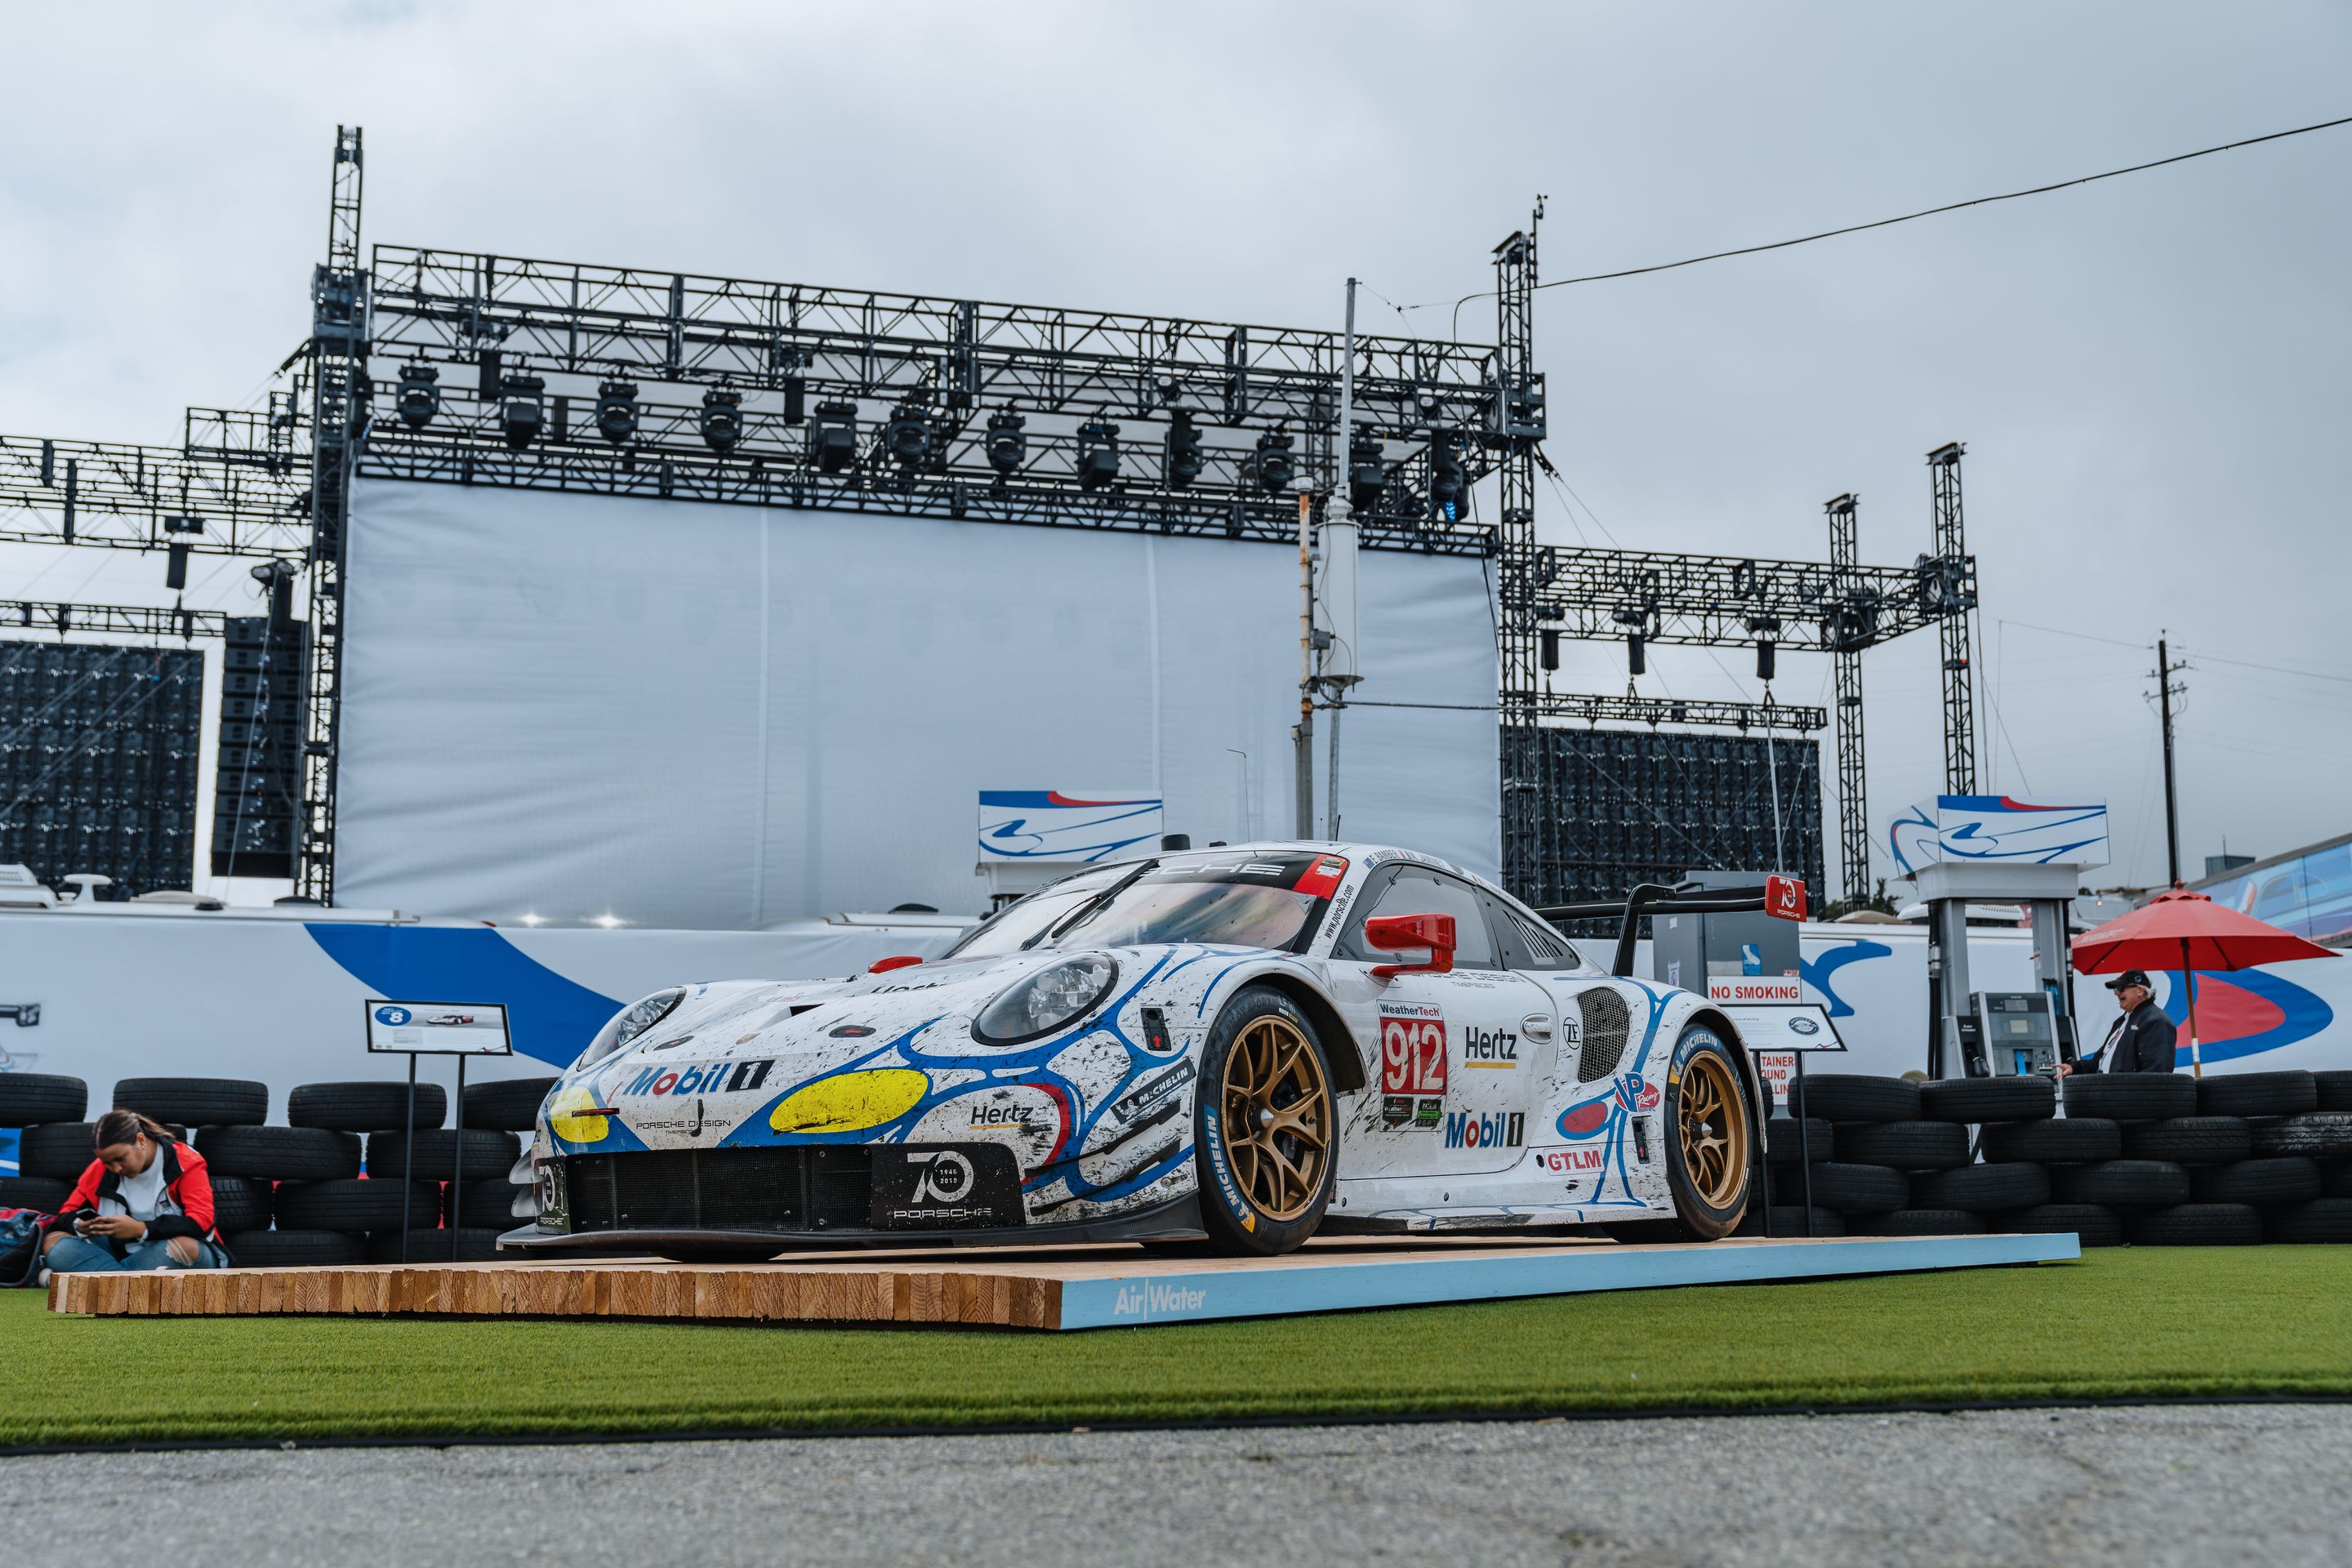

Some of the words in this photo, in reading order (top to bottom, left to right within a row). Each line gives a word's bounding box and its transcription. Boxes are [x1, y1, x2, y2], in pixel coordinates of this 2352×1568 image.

[1780, 878, 1796, 908] 70
[1324, 884, 1354, 939] www.porsche.com
[1777, 909, 1801, 919] PORSCHE
[1711, 986, 1731, 1000] NO
[1735, 986, 1799, 1000] SMOKING
[1380, 1004, 1440, 1018] WeatherTech
[1385, 1022, 1444, 1091] 912
[1465, 1027, 1517, 1060] Hertz
[1680, 1033, 1717, 1062] MICHELIN
[622, 1062, 732, 1096] Mobil
[1138, 1067, 1189, 1105] MICHELIN
[1613, 1072, 1646, 1113] VP
[1637, 1091, 1660, 1107] Racing
[636, 1120, 685, 1129] PORSCHE
[970, 1105, 1035, 1125] Hertz
[1445, 1112, 1507, 1149] Mobil
[1207, 1115, 1241, 1207] MICHELIN
[1548, 1150, 1601, 1172] GTLM
[907, 1150, 974, 1204] 70
[540, 1217, 564, 1225] PORSCHE
[893, 1207, 992, 1219] PORSCHE
